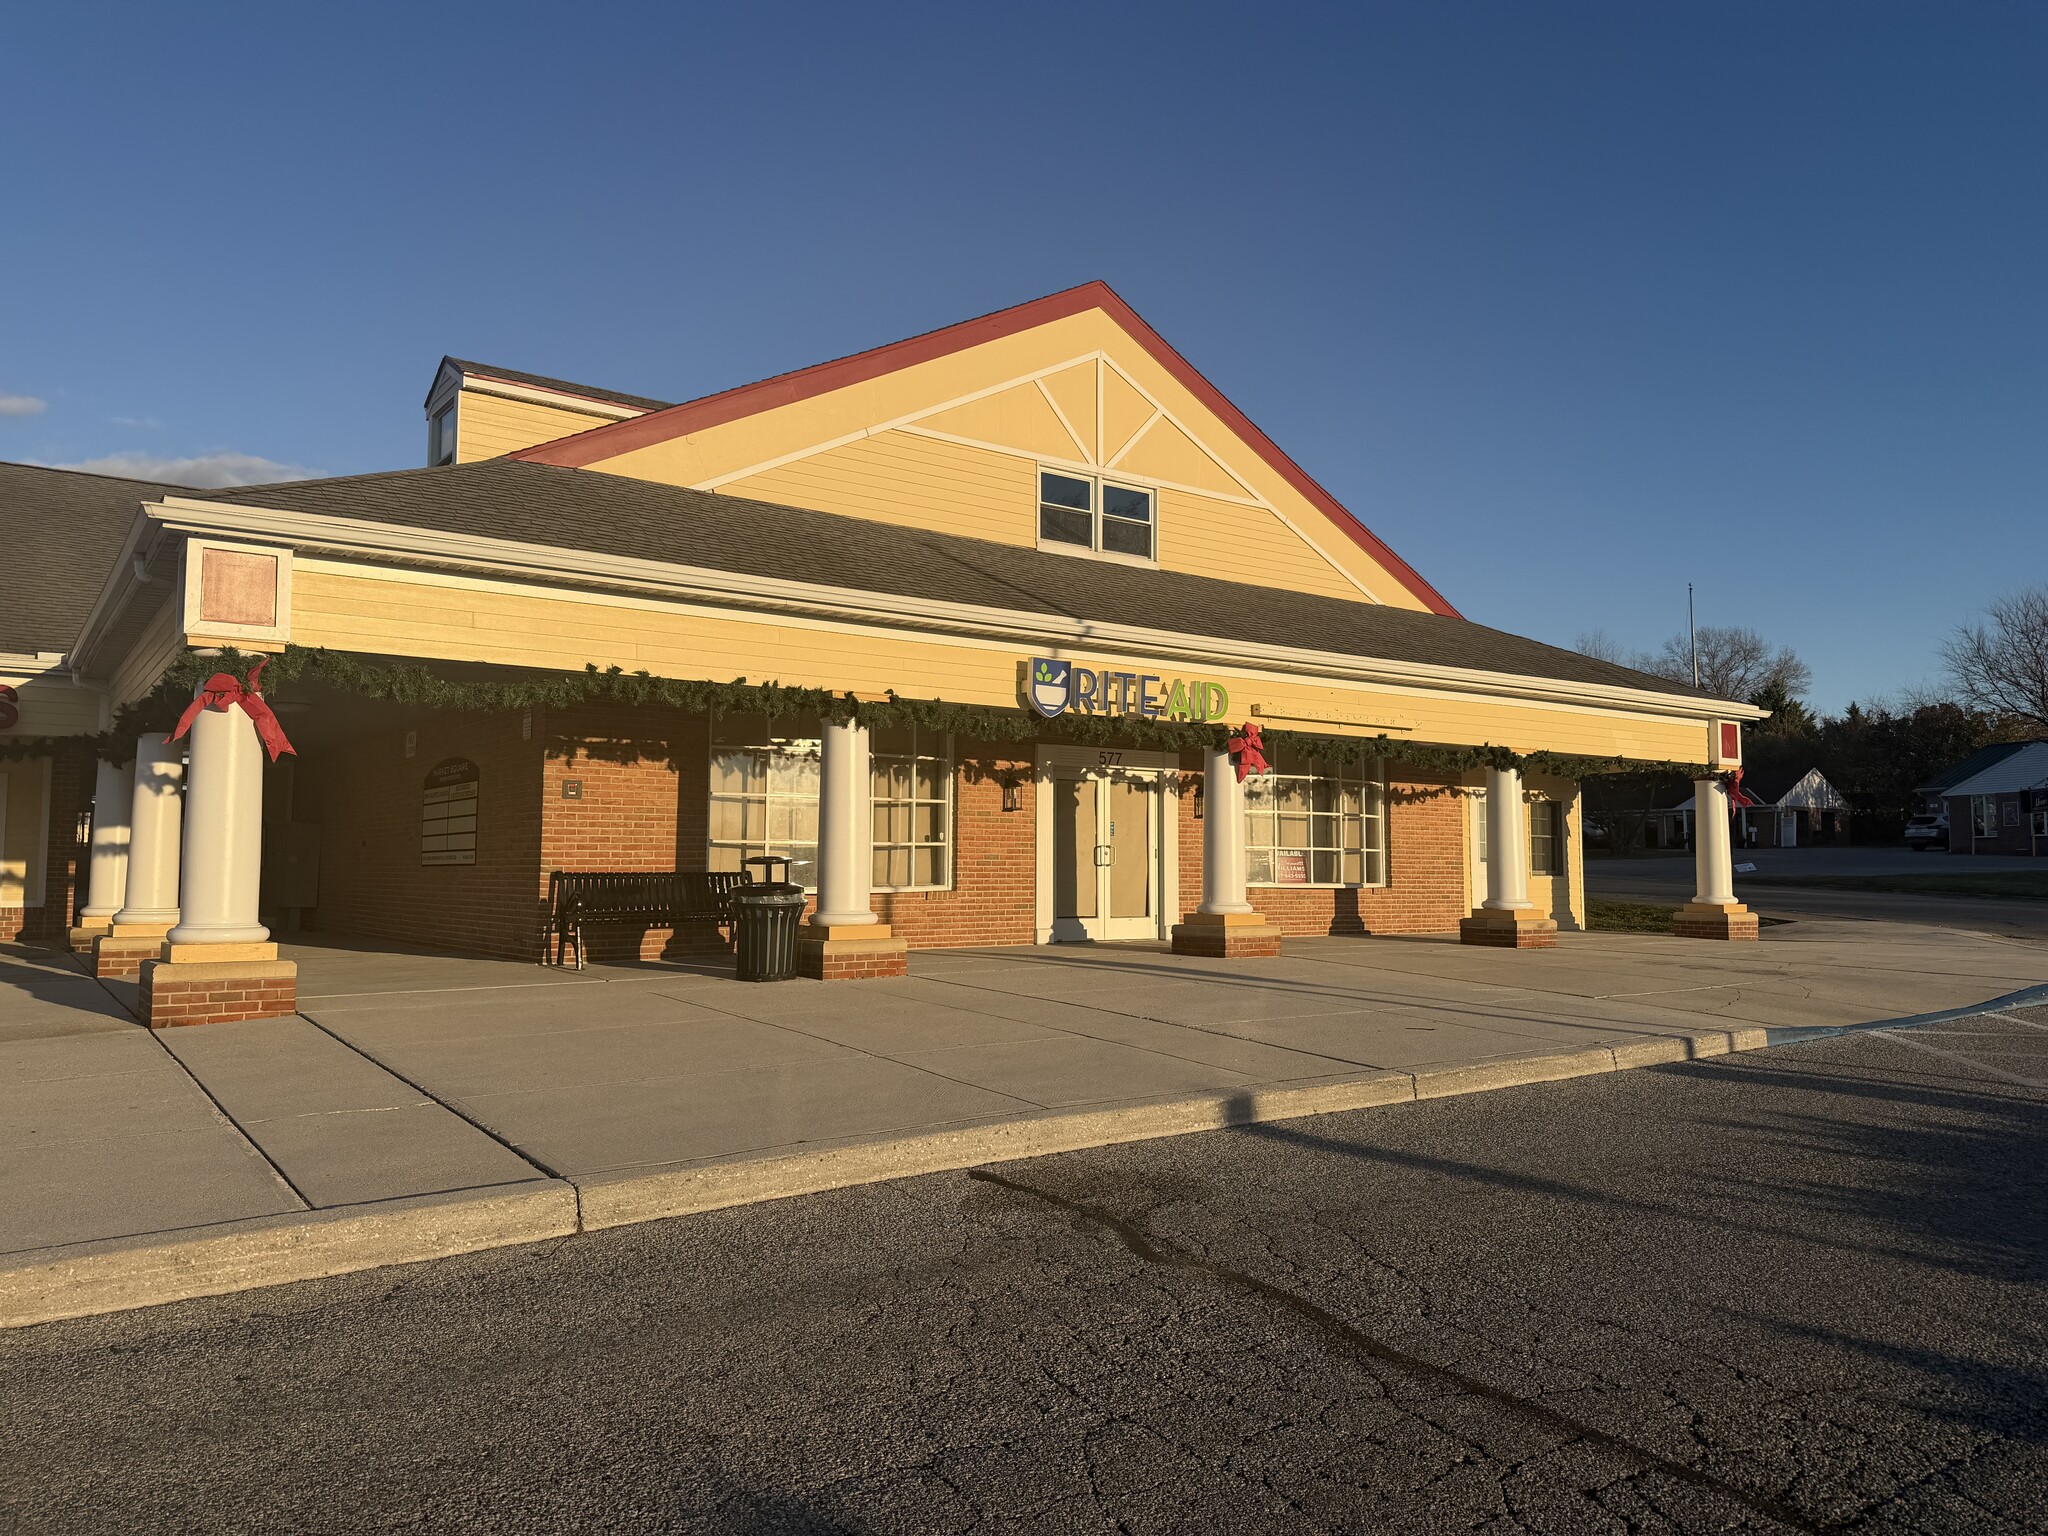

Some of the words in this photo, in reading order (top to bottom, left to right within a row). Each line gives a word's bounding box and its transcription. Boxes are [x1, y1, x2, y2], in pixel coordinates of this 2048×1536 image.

[1072, 667, 1160, 716] RITE
[1164, 678, 1229, 721] AID
[1099, 751, 1122, 765] 577
[432, 766, 449, 777] MARKET
[450, 762, 469, 774] SQUARE
